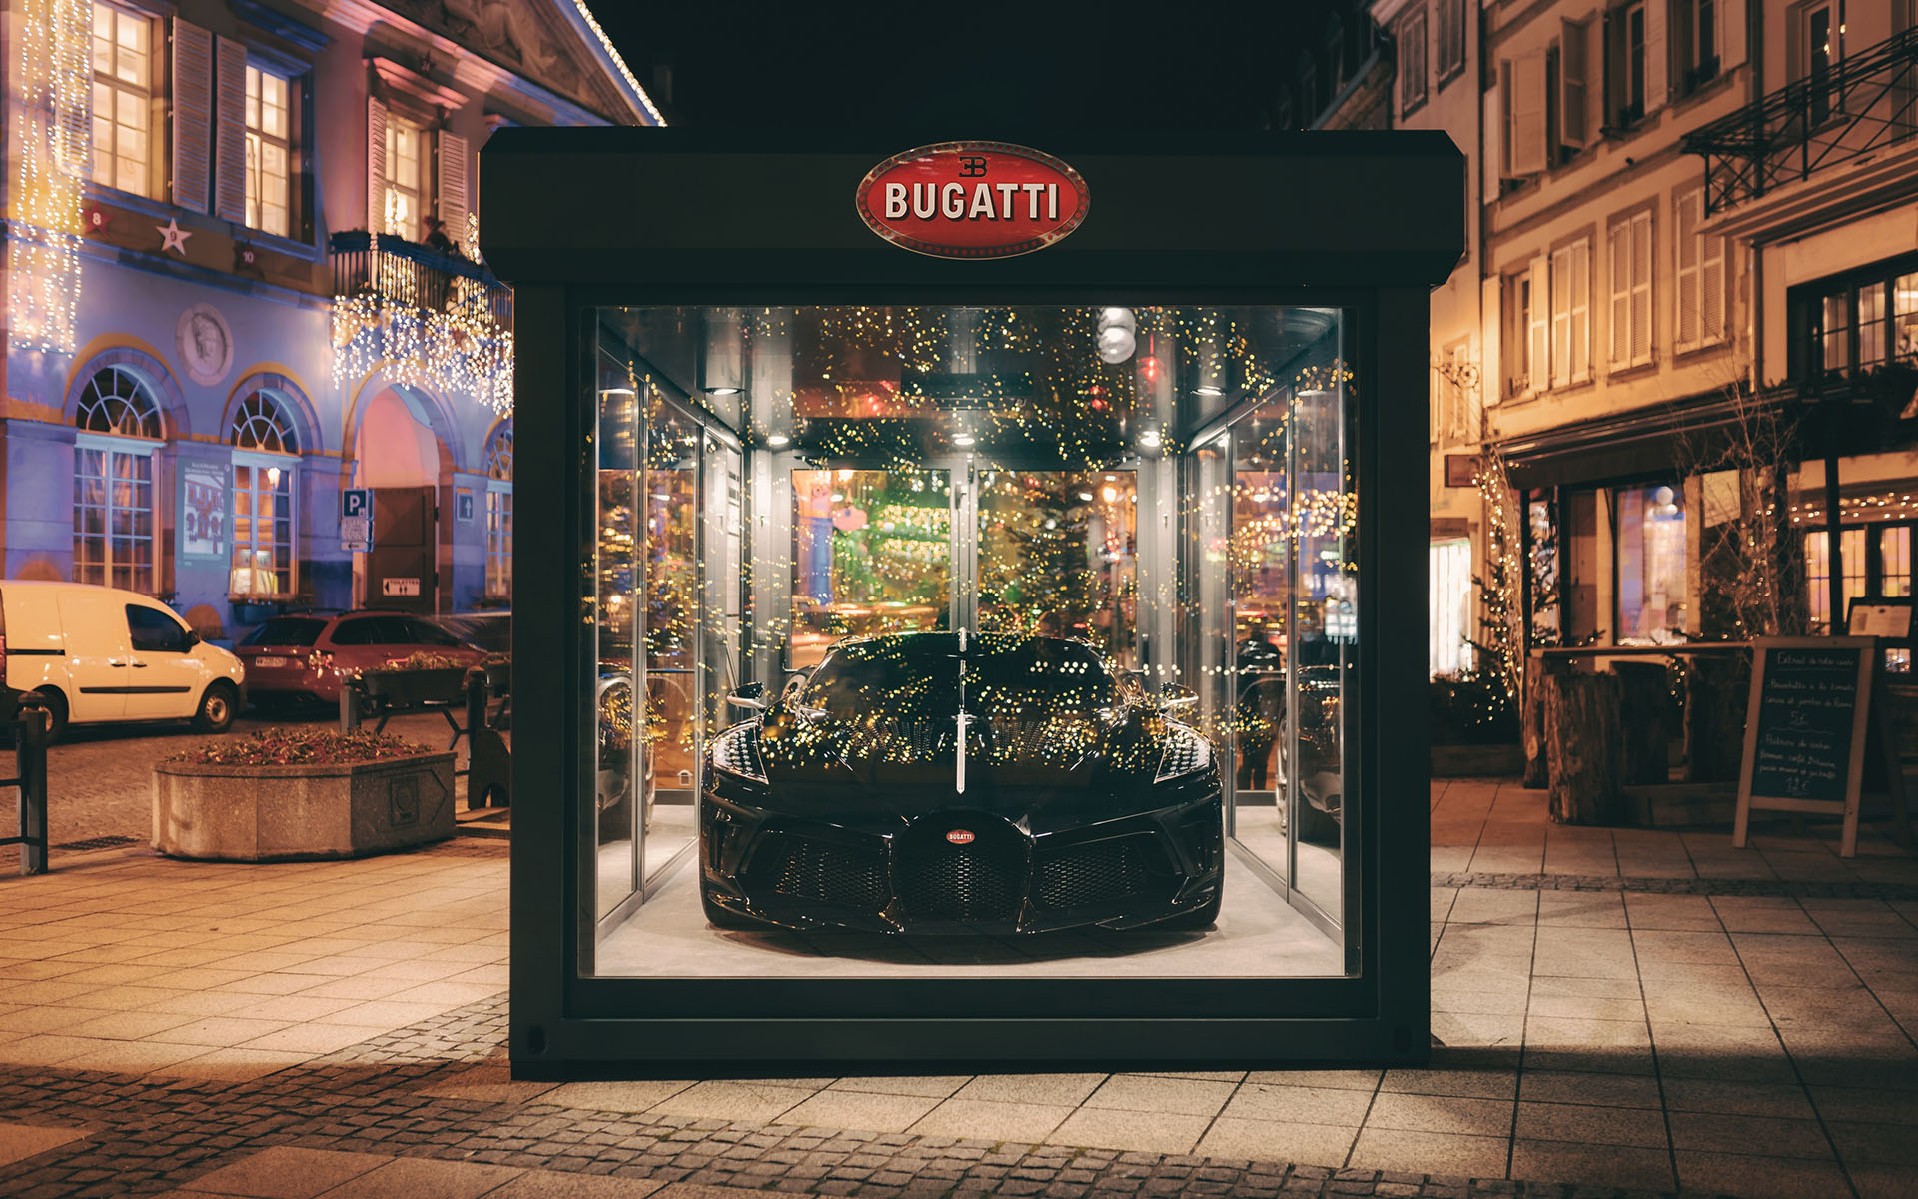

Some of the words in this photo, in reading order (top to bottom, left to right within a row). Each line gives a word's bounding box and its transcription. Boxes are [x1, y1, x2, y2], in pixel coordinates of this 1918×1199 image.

[885, 182, 1060, 221] BUGATTI
[92, 212, 102, 226] 8
[169, 231, 177, 242] 9
[243, 250, 255, 264] 10
[349, 494, 361, 513] P
